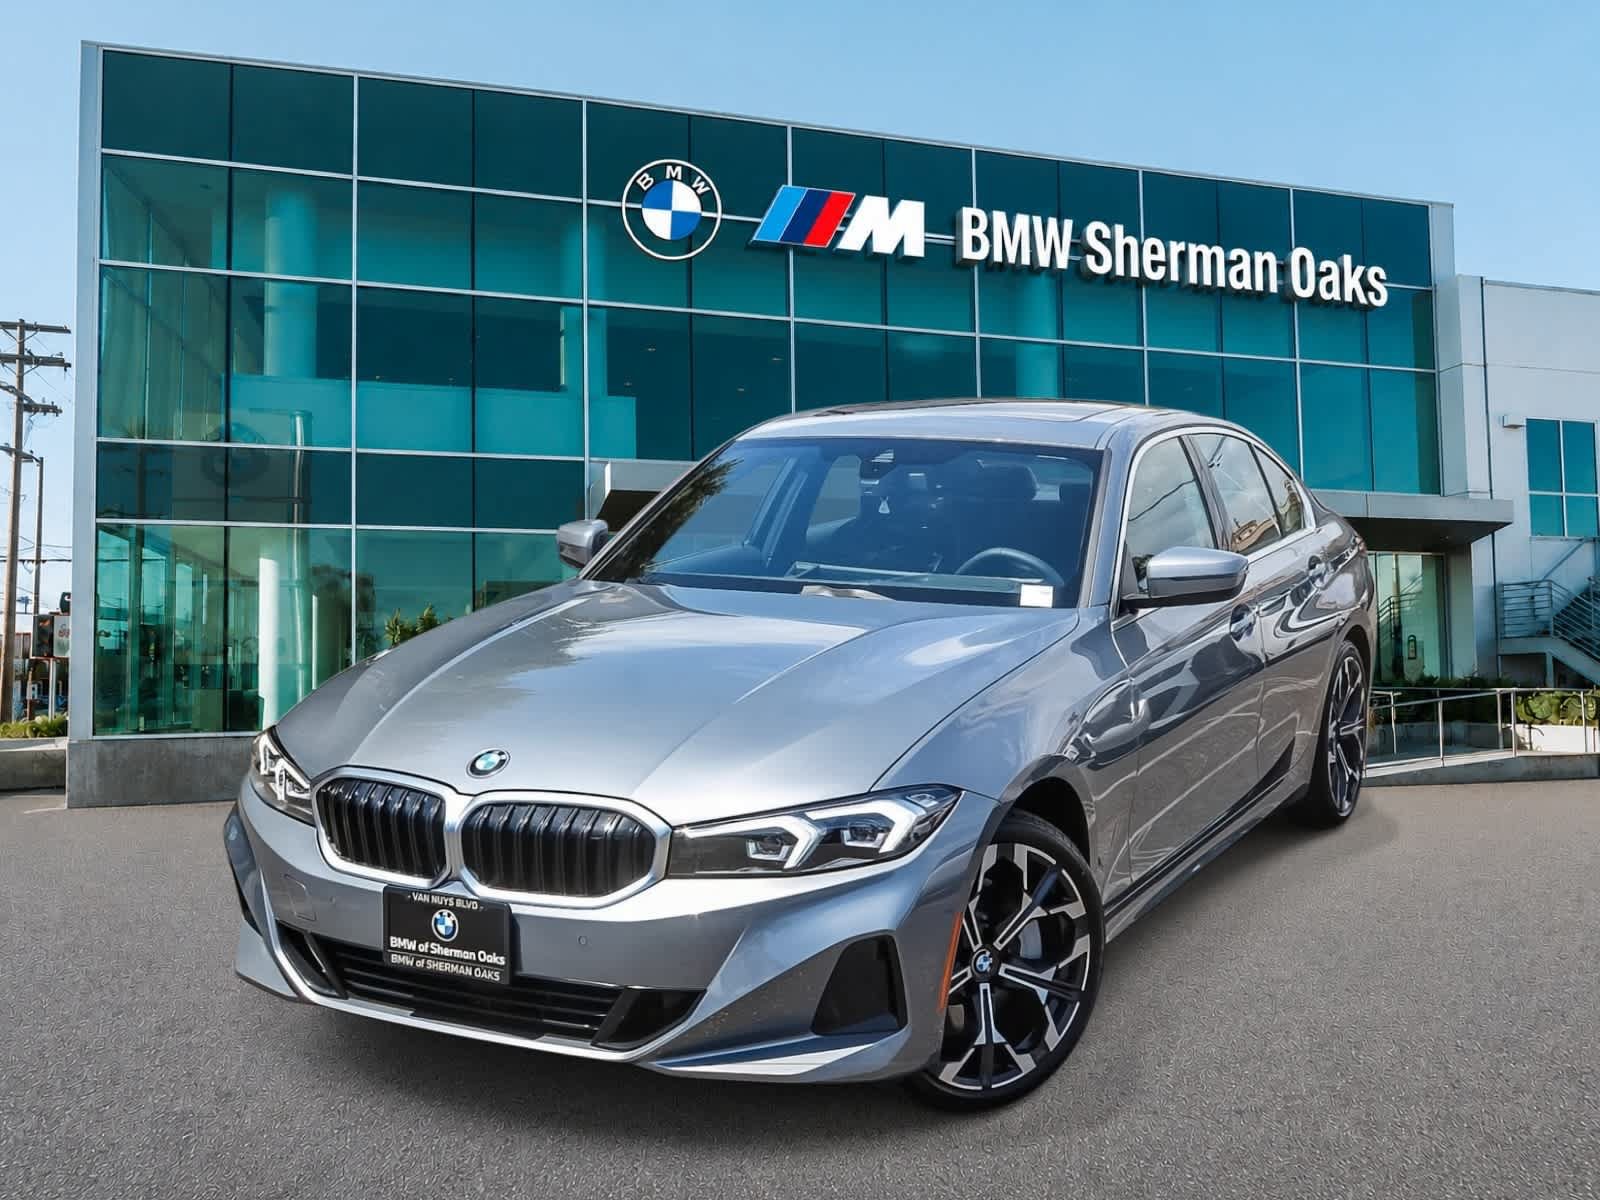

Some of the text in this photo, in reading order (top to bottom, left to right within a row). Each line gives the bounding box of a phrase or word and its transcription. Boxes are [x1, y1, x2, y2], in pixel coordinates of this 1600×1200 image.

[636, 165, 712, 196] BMW
[837, 195, 926, 258] M
[961, 206, 1389, 308] BMW Sherman Oaks
[412, 892, 479, 910] VAN NUYS BLVD
[390, 936, 506, 966] BMW of Sherman Oaks
[391, 954, 501, 982] BMW of SHERMAN OAKS
